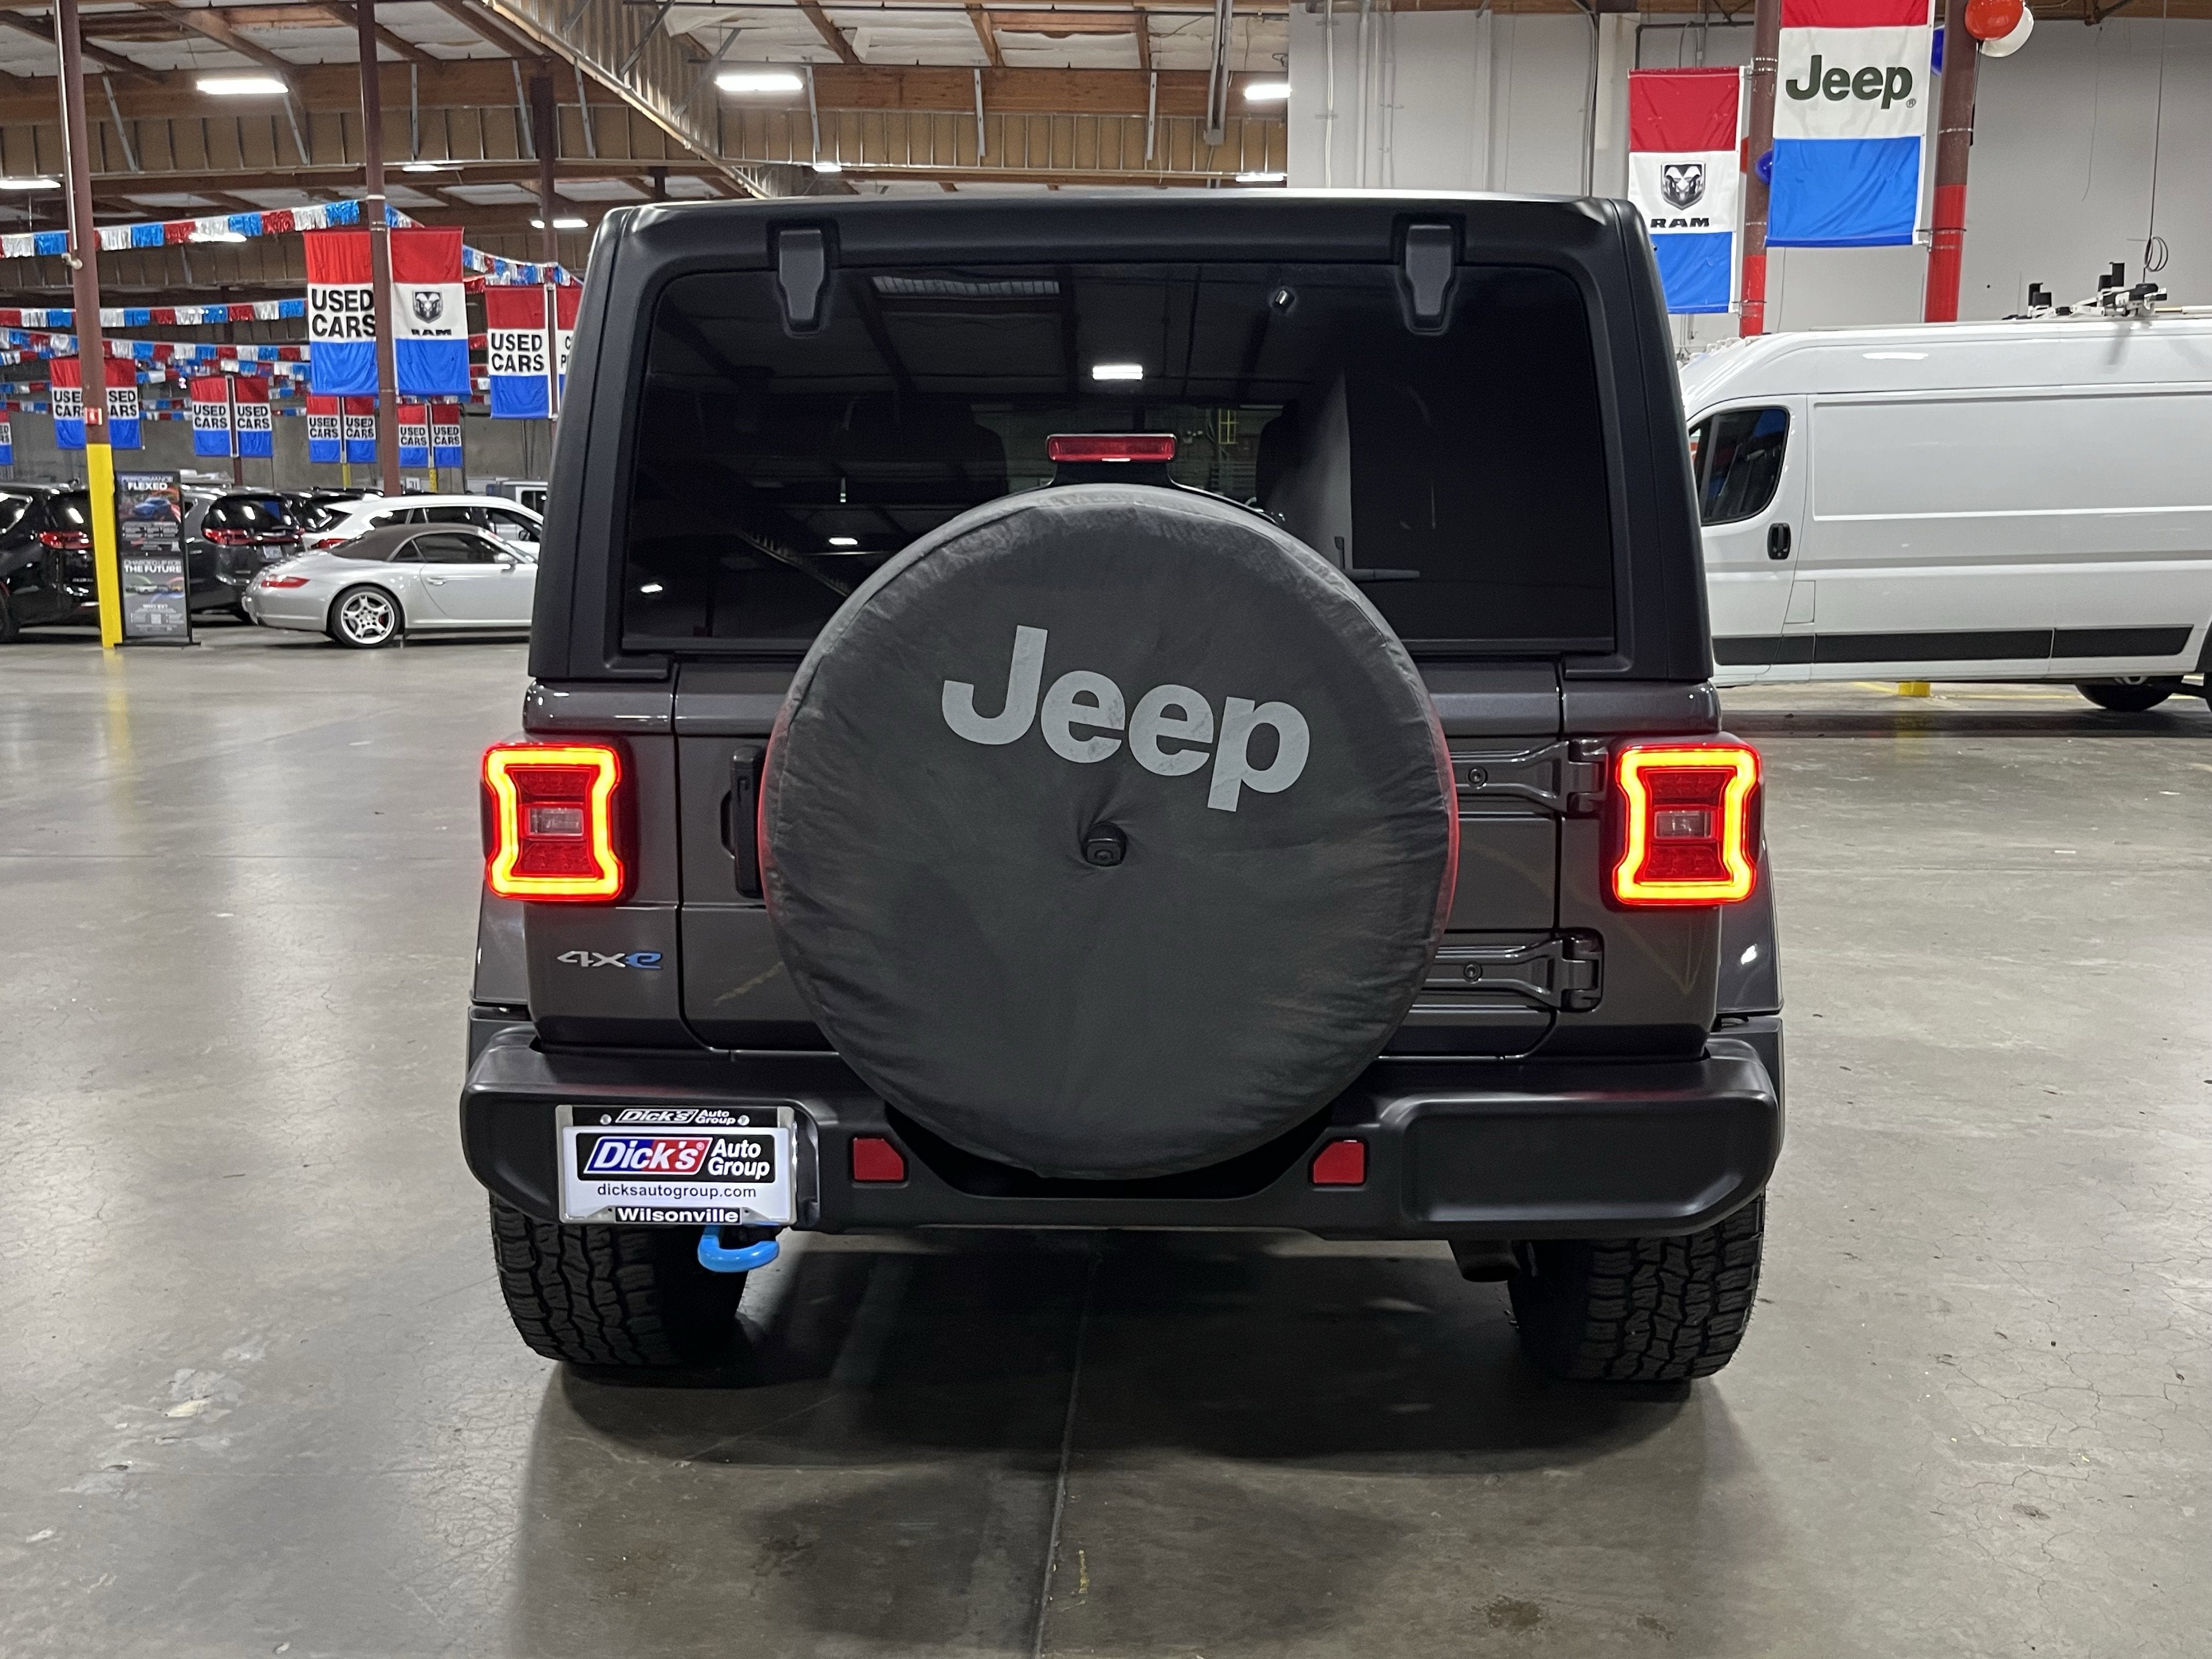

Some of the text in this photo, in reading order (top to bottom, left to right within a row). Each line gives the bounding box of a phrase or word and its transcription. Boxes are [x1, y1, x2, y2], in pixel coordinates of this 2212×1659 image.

[1786, 54, 1913, 109] Jeep
[1650, 217, 1710, 229] RAM
[312, 289, 374, 312] USED
[312, 314, 376, 338] CARS
[491, 333, 543, 352] USED
[492, 353, 544, 373] CARS
[54, 391, 83, 403] USE
[109, 391, 136, 403] SED
[55, 404, 84, 417] CAR
[110, 404, 137, 417] ARS
[194, 405, 226, 416] USED
[237, 405, 268, 416] USED
[194, 417, 228, 428] CARS
[237, 418, 270, 429] CARS
[309, 417, 337, 427] USED
[346, 417, 373, 427] USED
[310, 428, 338, 438] CARS
[346, 428, 374, 438] CARS
[400, 427, 426, 436] USED
[434, 427, 459, 436] USED
[400, 437, 427, 445] CARS
[434, 437, 460, 445] CARS
[128, 482, 168, 490] FLEXED
[941, 625, 1310, 812] Jeep
[621, 1109, 730, 1121] Dick's Auto
[695, 1116, 736, 1125] Group
[593, 1138, 761, 1170] Dick's Auto
[708, 1157, 770, 1180] Group
[597, 1183, 757, 1199] dicksautogroup.com
[617, 1207, 739, 1223] Wilsonville
